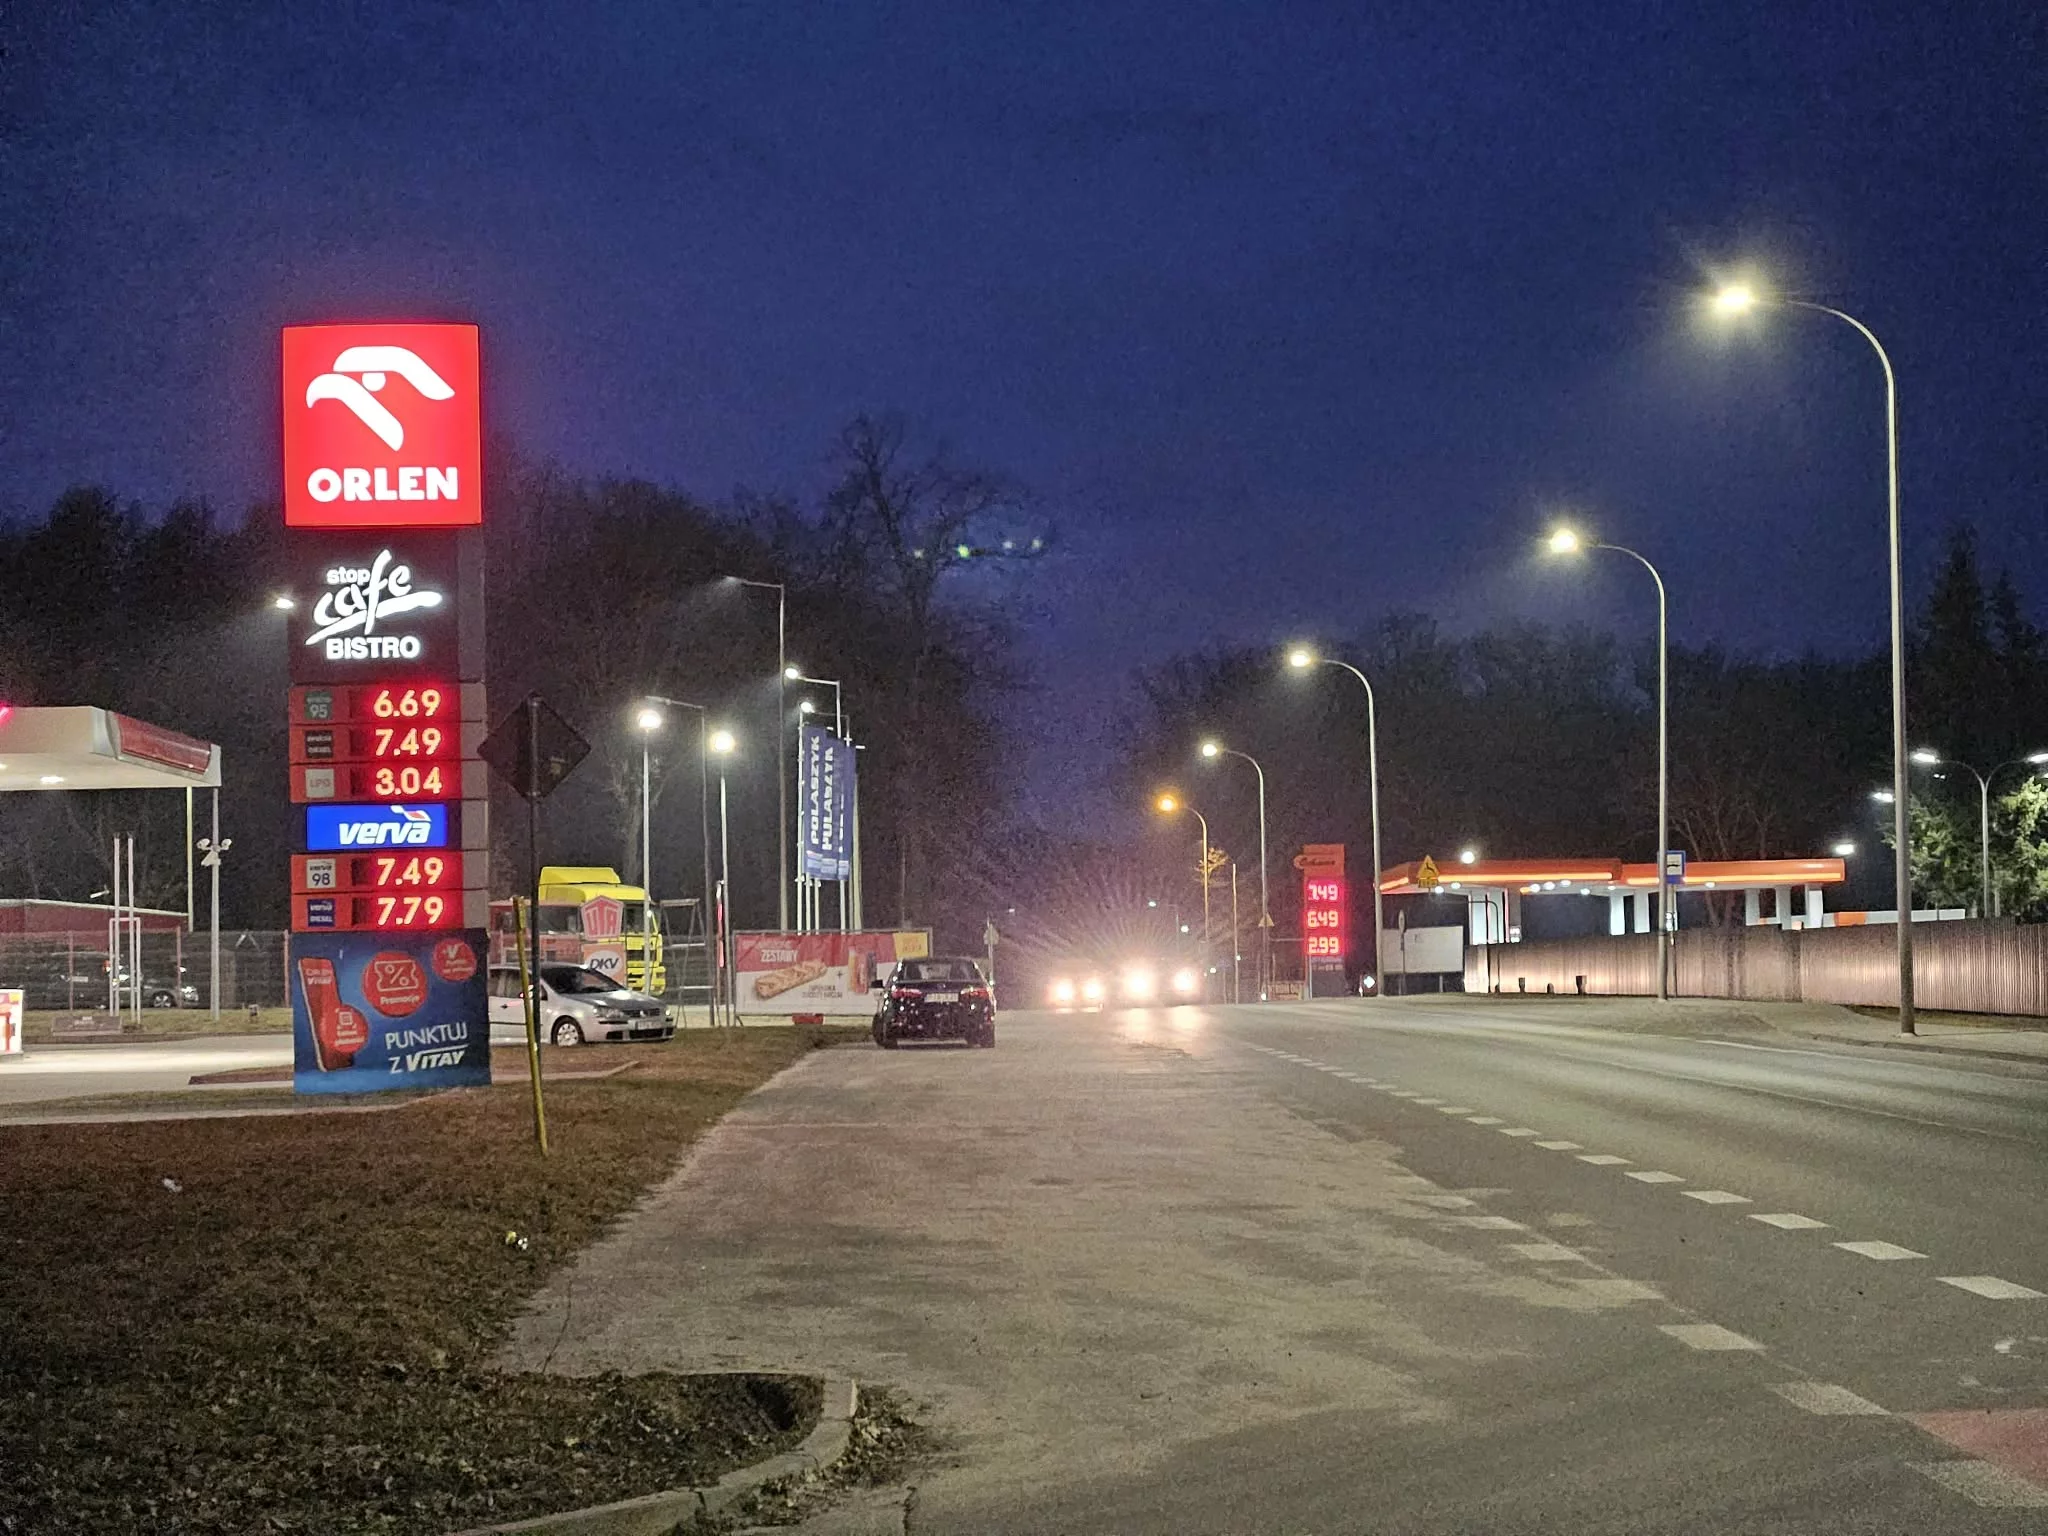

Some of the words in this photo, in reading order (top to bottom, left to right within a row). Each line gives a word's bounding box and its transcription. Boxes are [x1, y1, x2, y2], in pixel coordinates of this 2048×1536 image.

[308, 467, 458, 502] ORLEN
[326, 566, 371, 585] stop
[326, 637, 420, 660] BISTRO
[309, 704, 328, 718] 95
[373, 689, 441, 717] 6.69
[375, 728, 441, 756] 7.49
[375, 767, 442, 795] 3.04
[338, 819, 432, 845] verva
[312, 873, 330, 886] 98
[377, 857, 444, 885] 7.49
[377, 896, 444, 925] 7.79
[589, 957, 619, 970] DKV
[385, 1022, 468, 1050] PUNKTUJ
[388, 1057, 403, 1074] Z
[406, 1046, 468, 1073] VITAY
